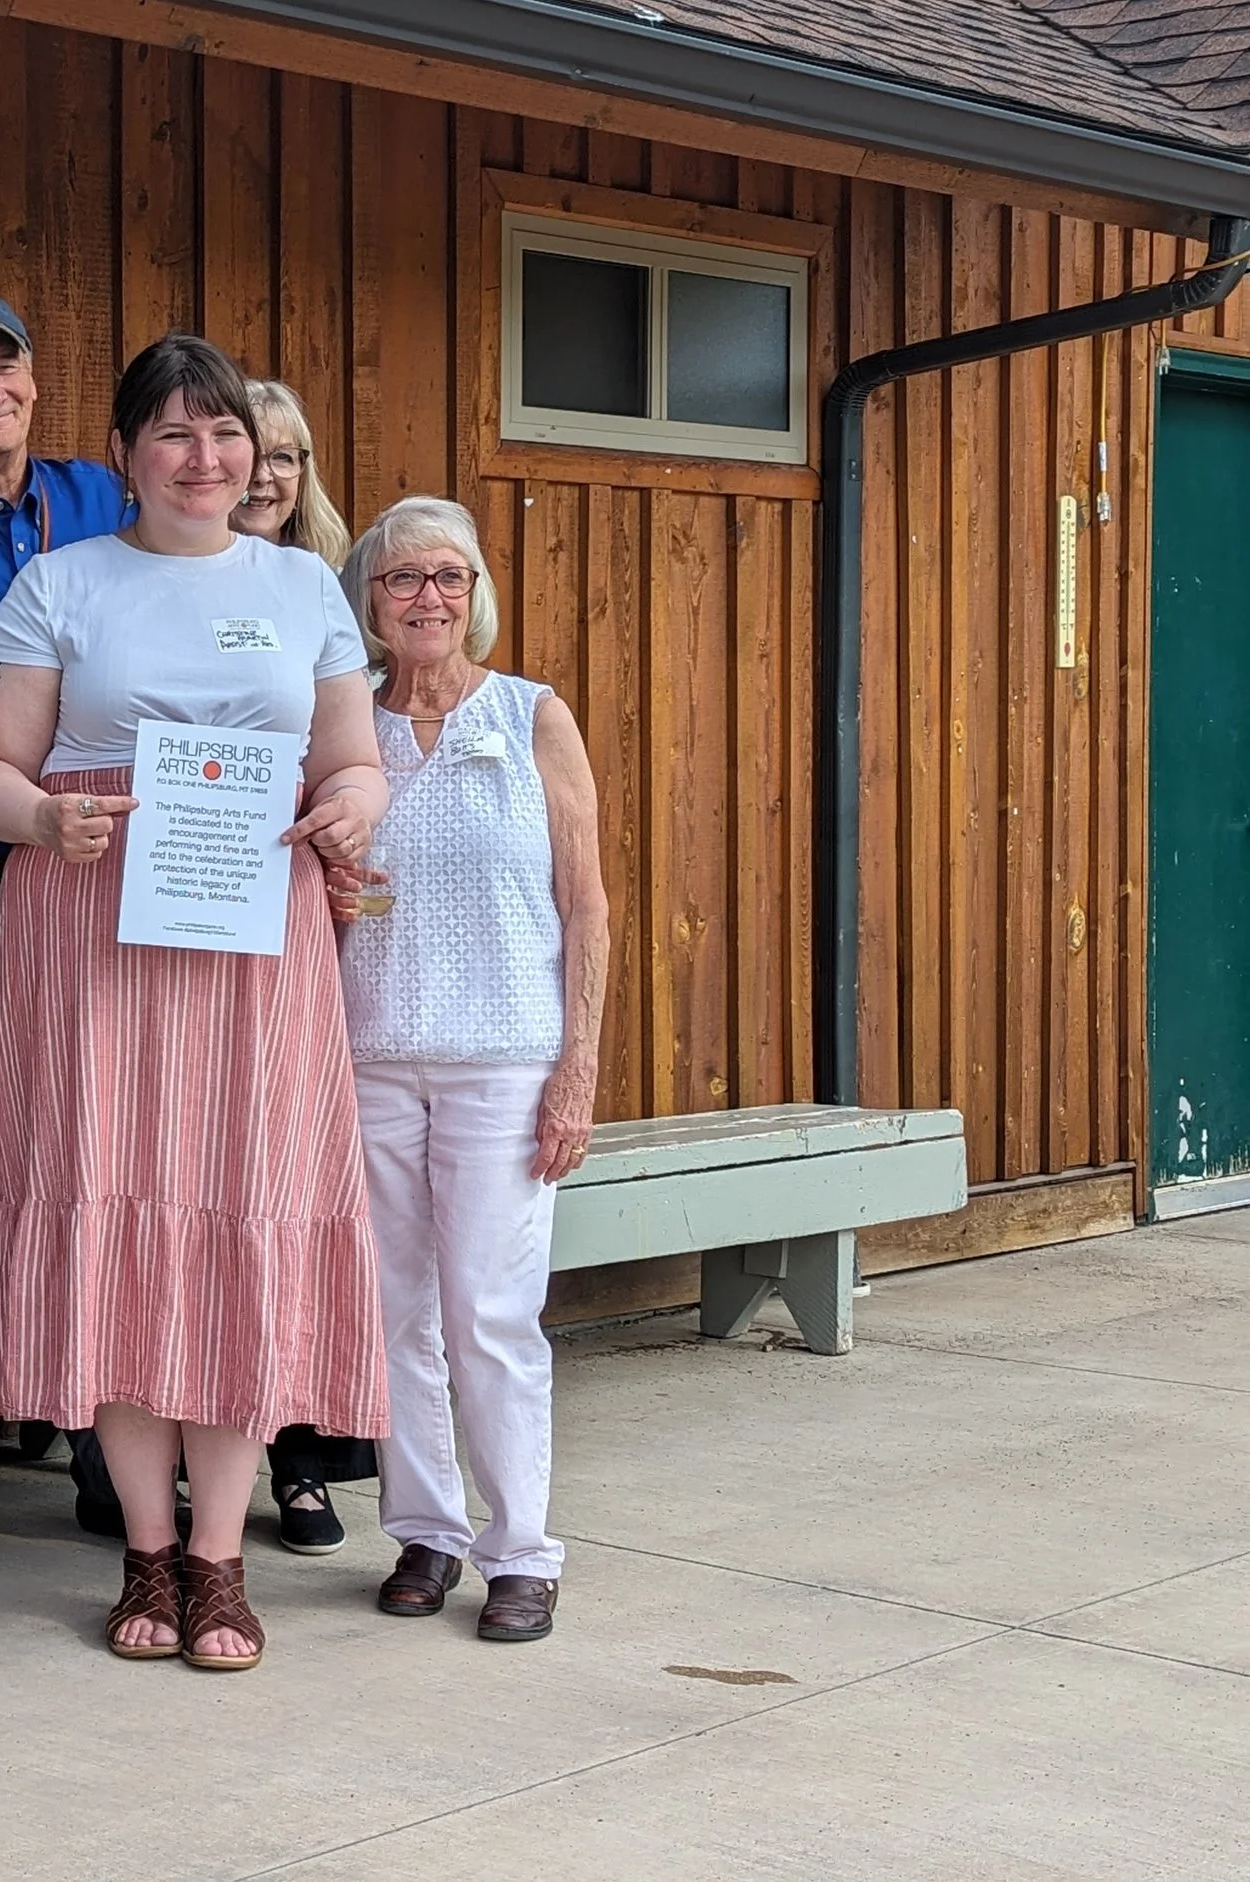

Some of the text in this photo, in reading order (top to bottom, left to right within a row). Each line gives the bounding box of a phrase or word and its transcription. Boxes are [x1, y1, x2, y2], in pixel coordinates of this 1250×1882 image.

[158, 737, 273, 764] PHILIPSBURG
[155, 757, 272, 783] ARTS FUND
[155, 801, 267, 821] The Philipsburg Arts Fund
[168, 815, 250, 831] is dedicated to the
[168, 828, 248, 843] encouragement of
[155, 839, 259, 856] performing and fine arts
[149, 850, 263, 869] and to the celebration and
[153, 863, 257, 881] protection of the unique
[166, 875, 241, 892] historic legacy of
[155, 886, 250, 904] Philipsburg, Montana.
